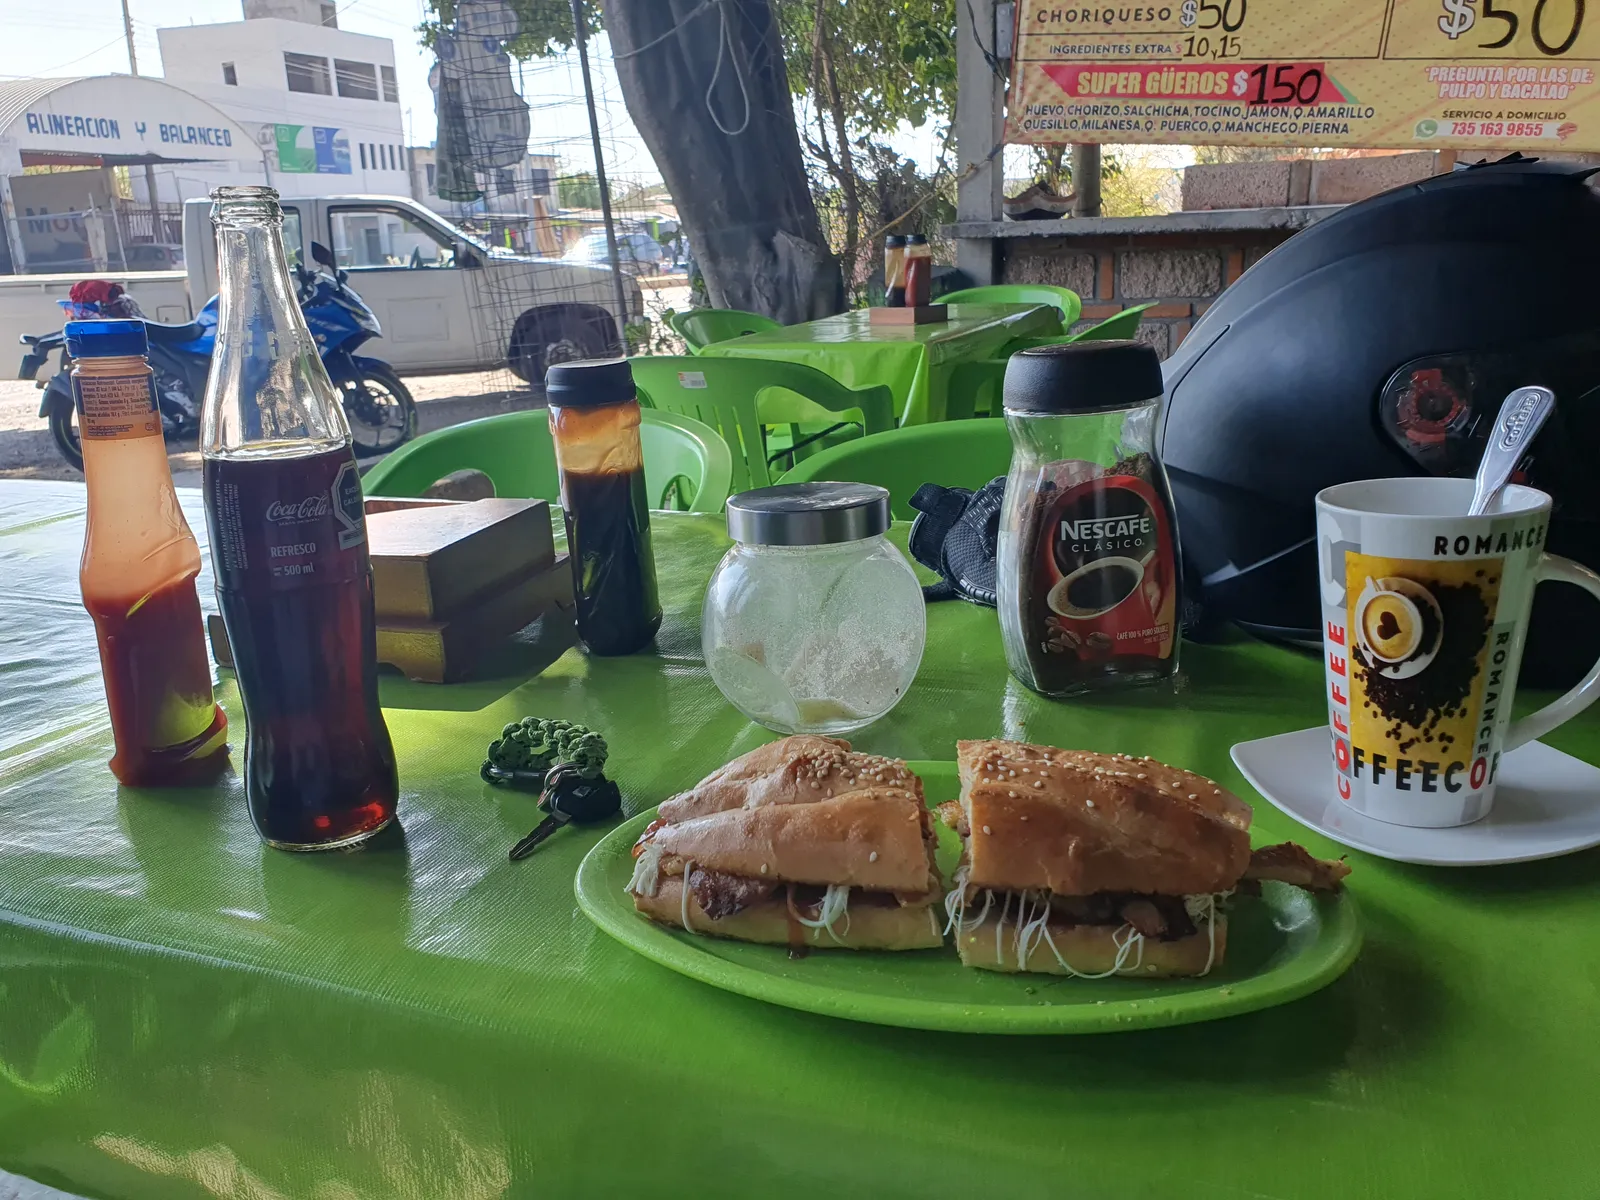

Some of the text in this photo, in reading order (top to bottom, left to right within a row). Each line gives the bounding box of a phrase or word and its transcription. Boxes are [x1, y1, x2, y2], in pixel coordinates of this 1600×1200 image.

[1037, 7, 1172, 25] CHORIQUESO
[1049, 44, 1131, 55] INGREDIENTES
[1134, 44, 1172, 54] EXTRA
[1077, 71, 1142, 95] SUPER
[1146, 67, 1229, 95] GÜEROS
[1506, 67, 1538, 83] POR
[1540, 68, 1568, 83] LAS
[1438, 83, 1487, 99] PULPO
[1489, 84, 1500, 98] Y
[1442, 110, 1567, 120] SERVICIO A DOMICILIO
[26, 112, 233, 147] ALINEACION Y BALANCEO
[1451, 122, 1544, 136] 735 163 9855
[265, 496, 329, 522] Coca-Cola
[1434, 524, 1544, 556] ROMANCE
[270, 542, 317, 558] REFRESCO
[284, 565, 302, 576] 500
[303, 562, 315, 574] ml
